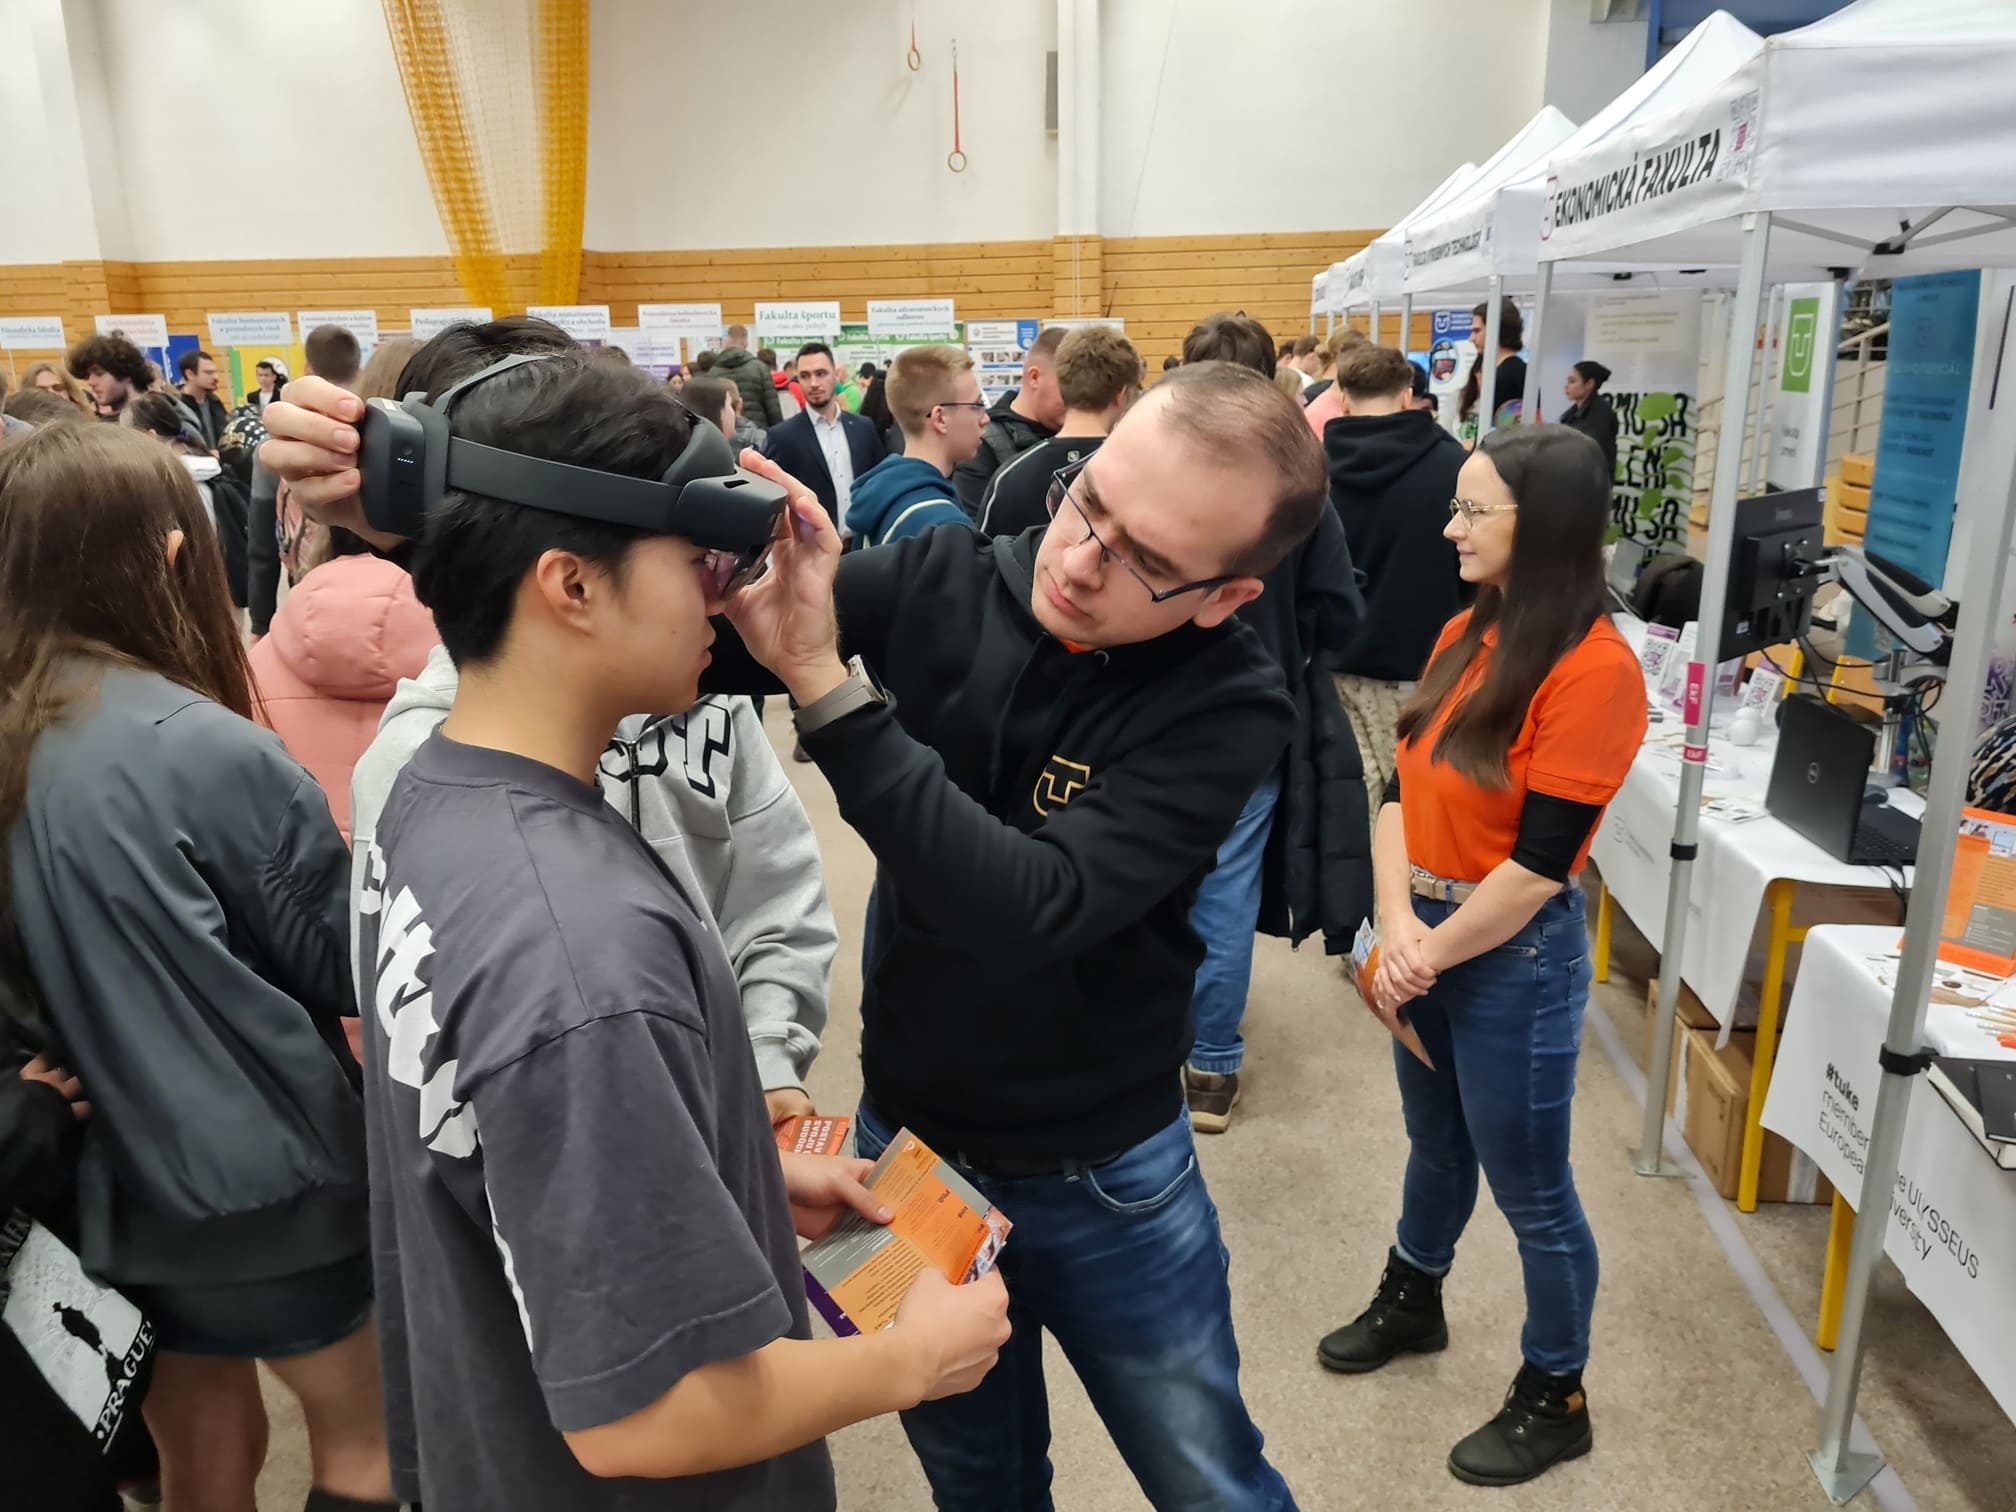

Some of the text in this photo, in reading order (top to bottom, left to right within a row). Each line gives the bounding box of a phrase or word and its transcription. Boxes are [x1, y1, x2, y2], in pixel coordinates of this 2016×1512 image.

[1555, 152, 1638, 227] EKONOMICKÁ
[1635, 128, 1720, 204] FAKULTA
[759, 309, 837, 322] Fakulta športu
[1825, 1061, 1859, 1111] #tuke
[805, 1120, 822, 1149] SVOJU
[813, 1120, 832, 1152] POSTAV
[1819, 1111, 1864, 1175] Europea
[1822, 1090, 1870, 1151] member
